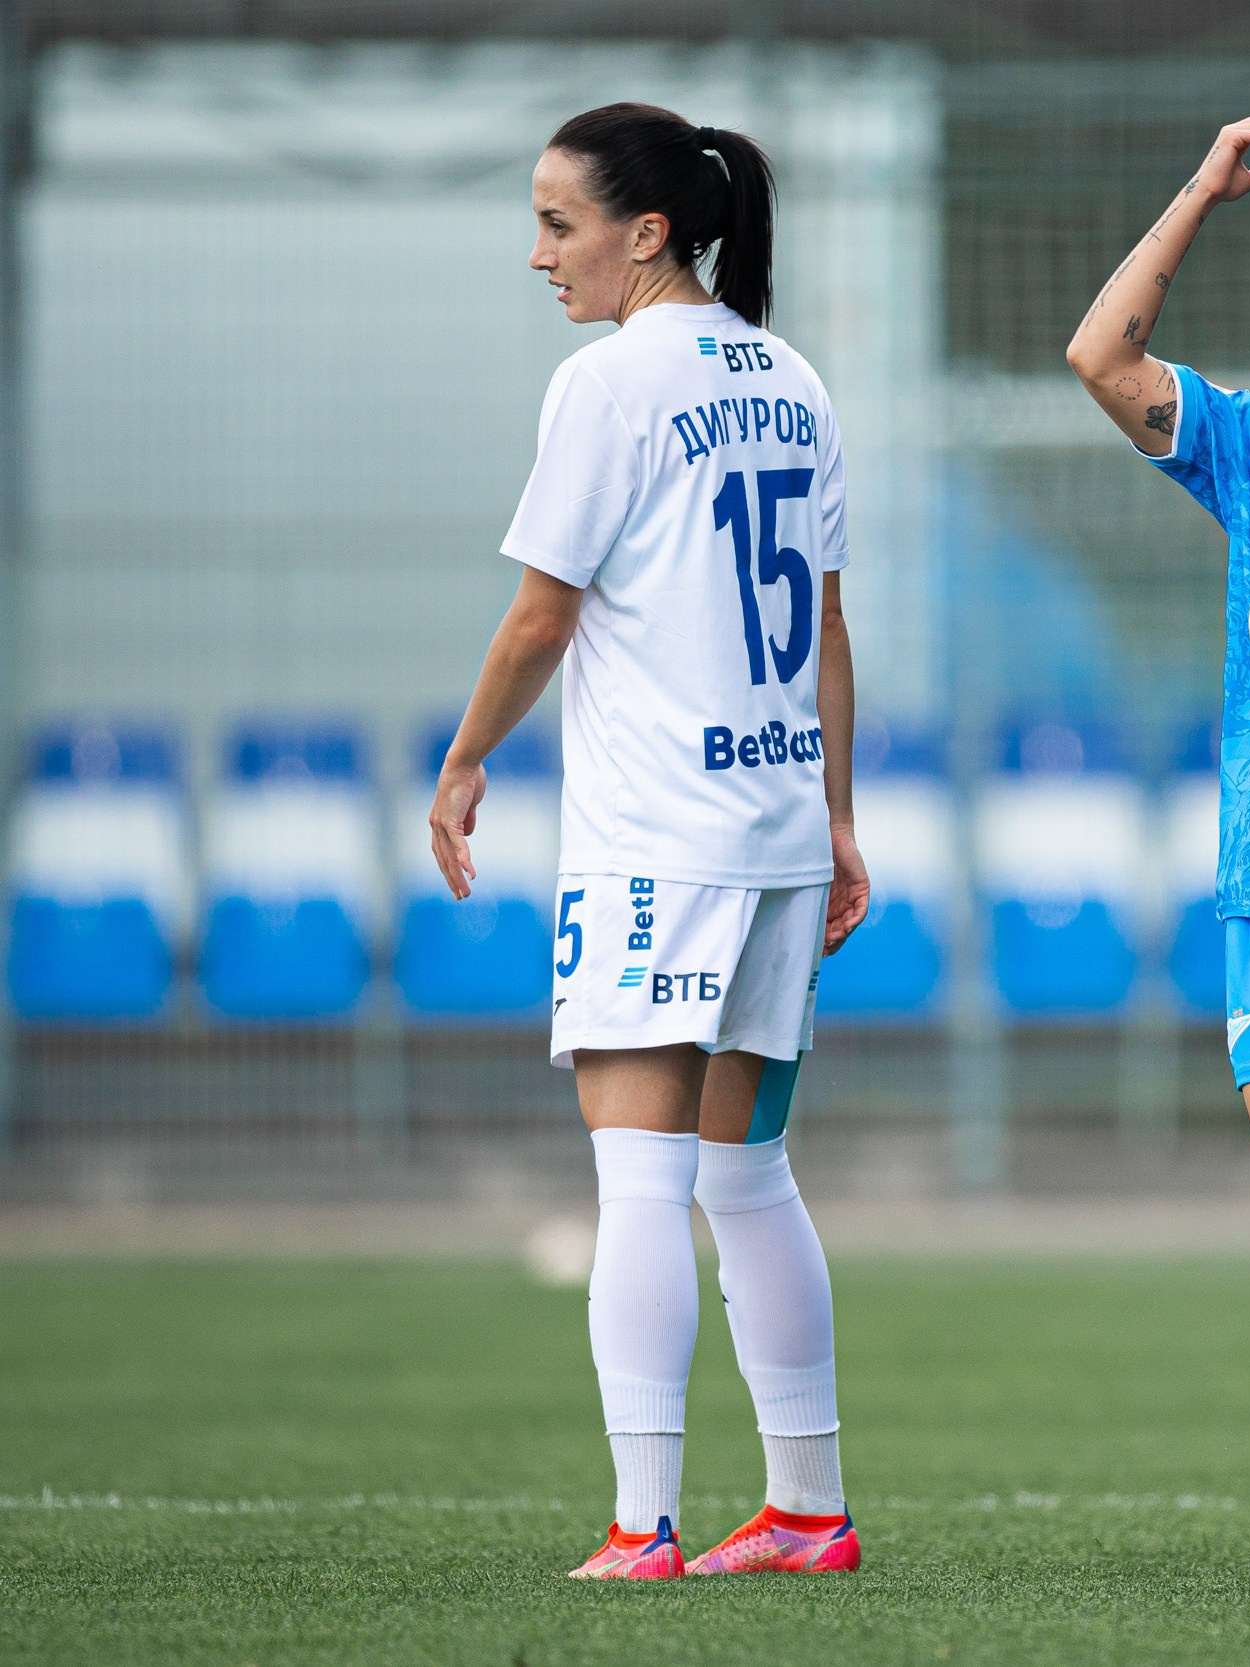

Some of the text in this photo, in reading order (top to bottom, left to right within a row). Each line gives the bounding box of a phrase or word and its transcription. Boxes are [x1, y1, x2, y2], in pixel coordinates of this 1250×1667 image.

[721, 342, 773, 373] ВТБ
[712, 468, 815, 686] 15
[652, 972, 722, 1004] ВТБ
